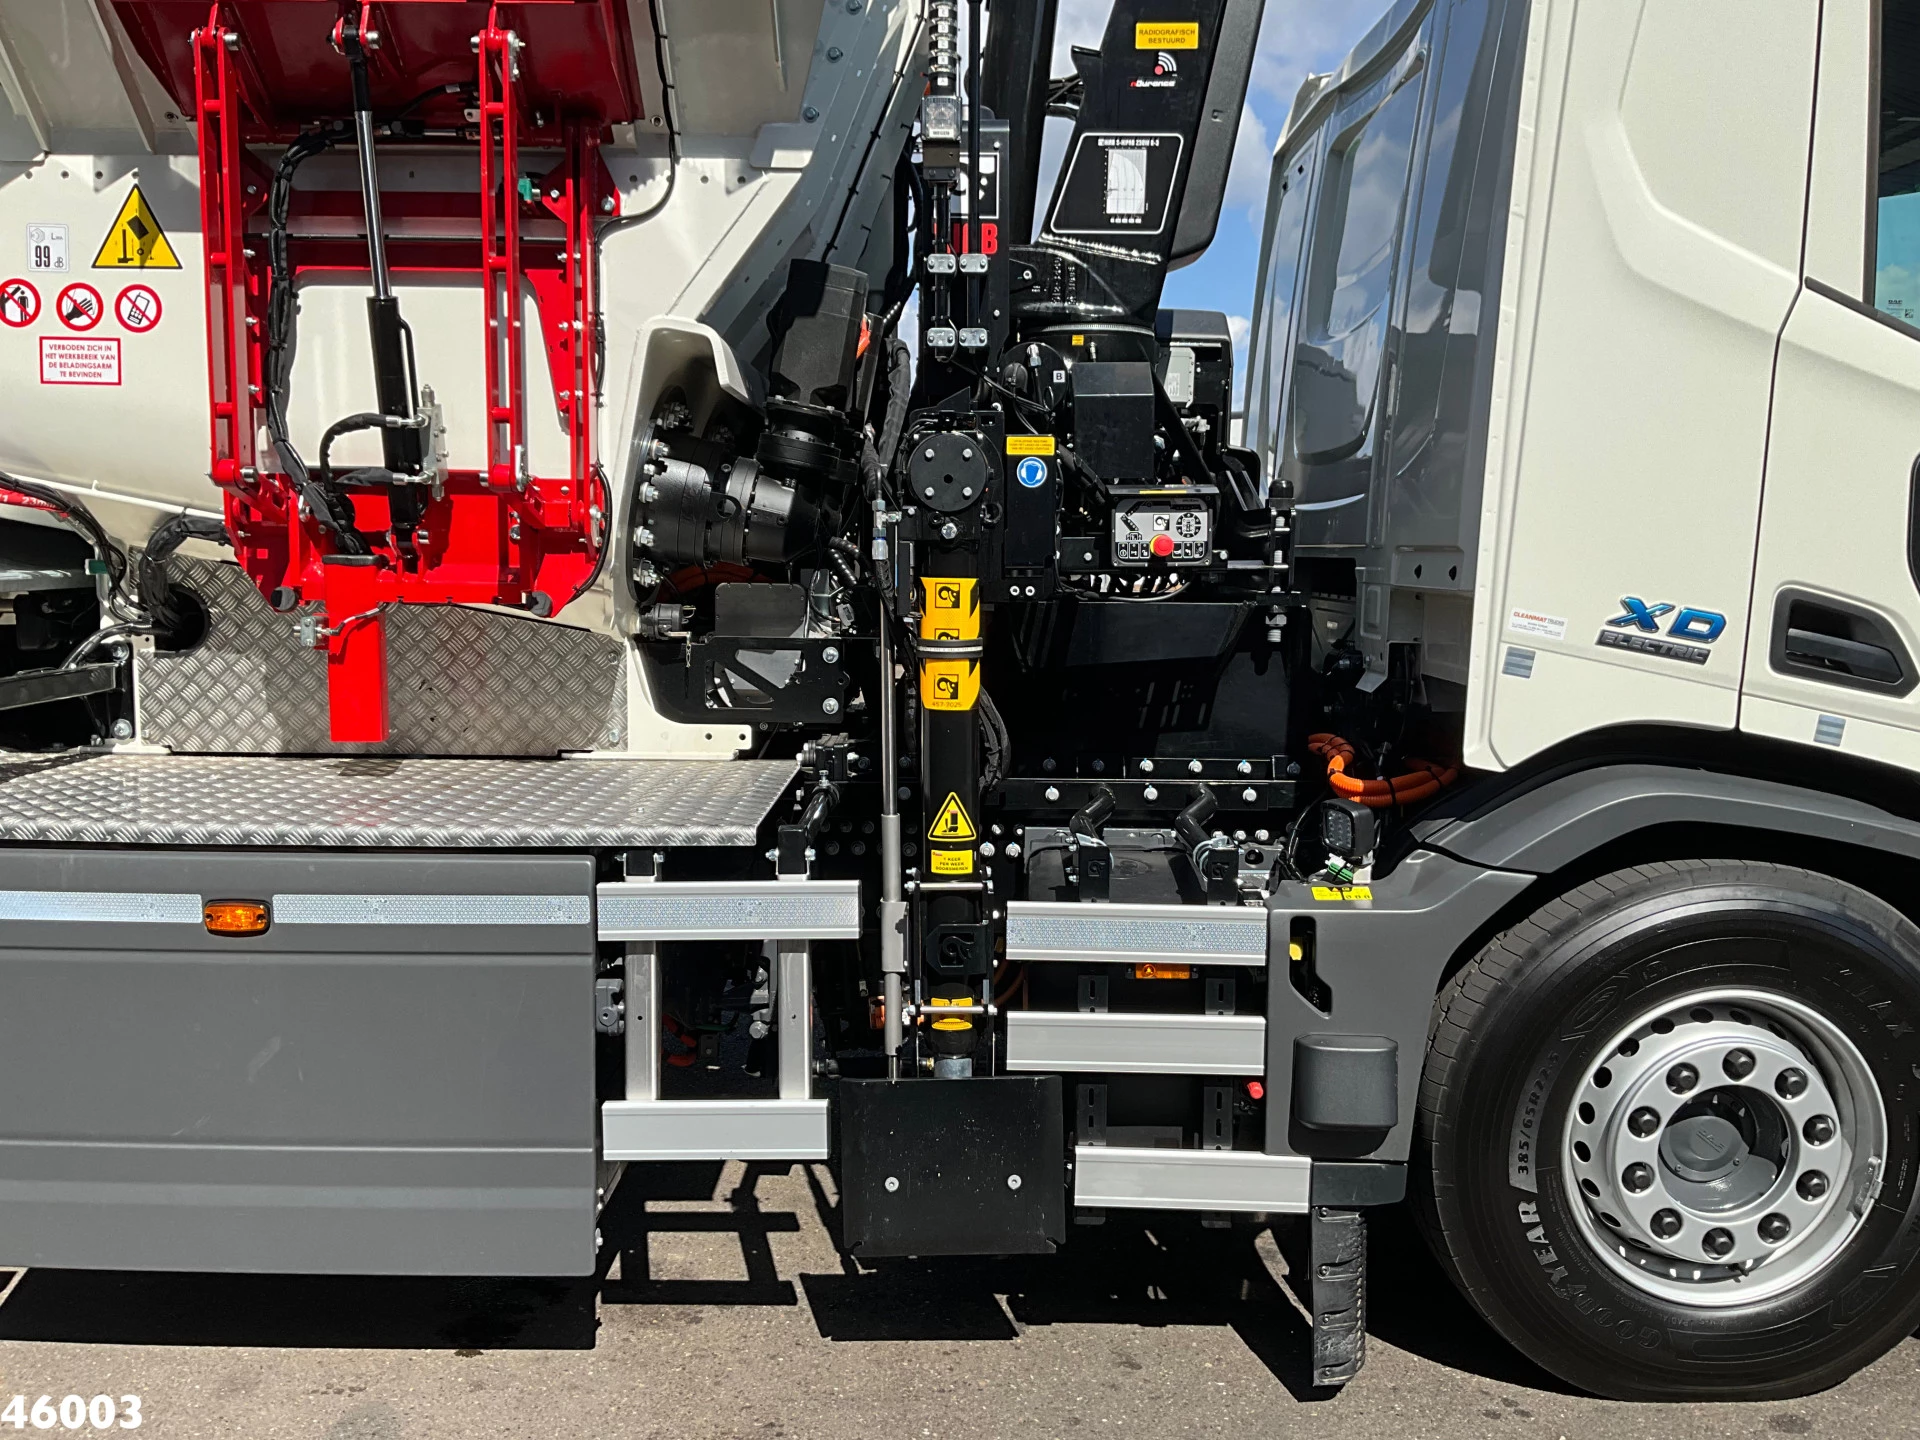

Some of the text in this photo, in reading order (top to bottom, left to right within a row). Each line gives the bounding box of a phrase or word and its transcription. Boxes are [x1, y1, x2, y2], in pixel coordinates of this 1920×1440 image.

[35, 245, 51, 268] 99
[54, 257, 64, 268] dB
[1056, 372, 1062, 381] B
[1605, 596, 1727, 644] XD
[1600, 630, 1710, 662] ELECTRIC
